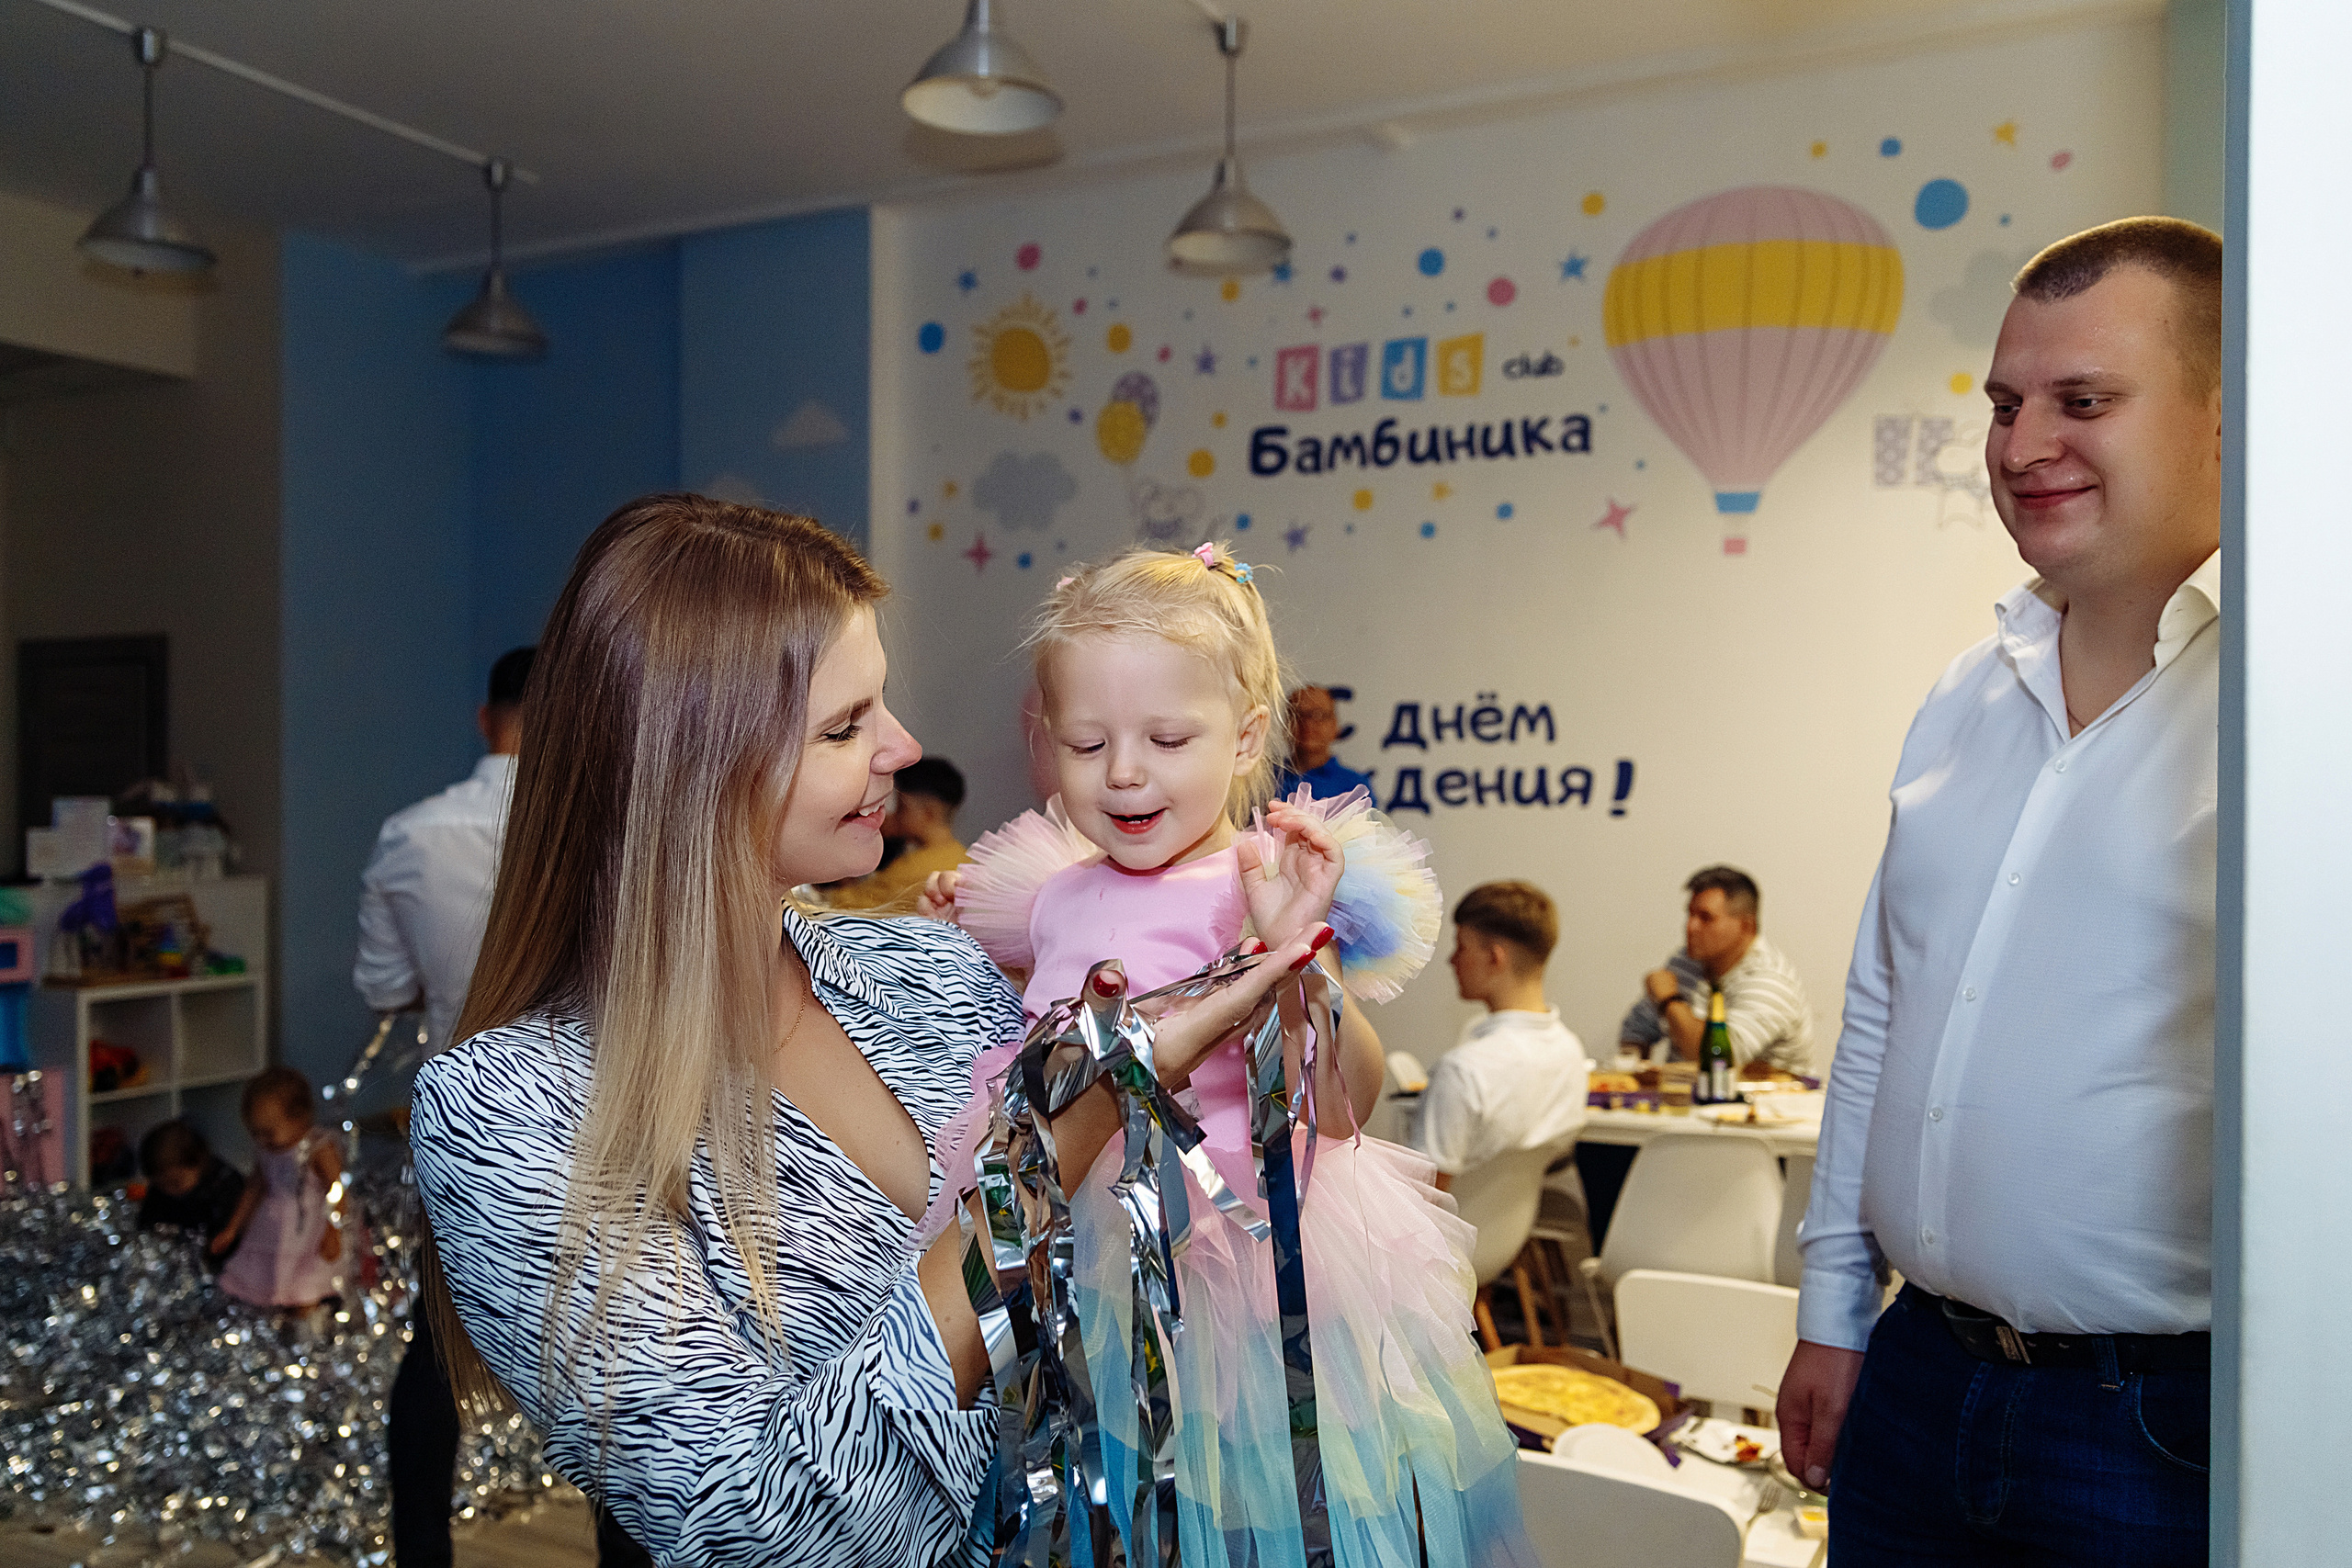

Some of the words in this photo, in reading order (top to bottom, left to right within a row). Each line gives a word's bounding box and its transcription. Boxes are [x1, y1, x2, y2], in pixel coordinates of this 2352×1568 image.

[1250, 413, 1592, 476] Бамбиника
[1383, 692, 1556, 750] днём
[1367, 761, 1635, 817] дения!
